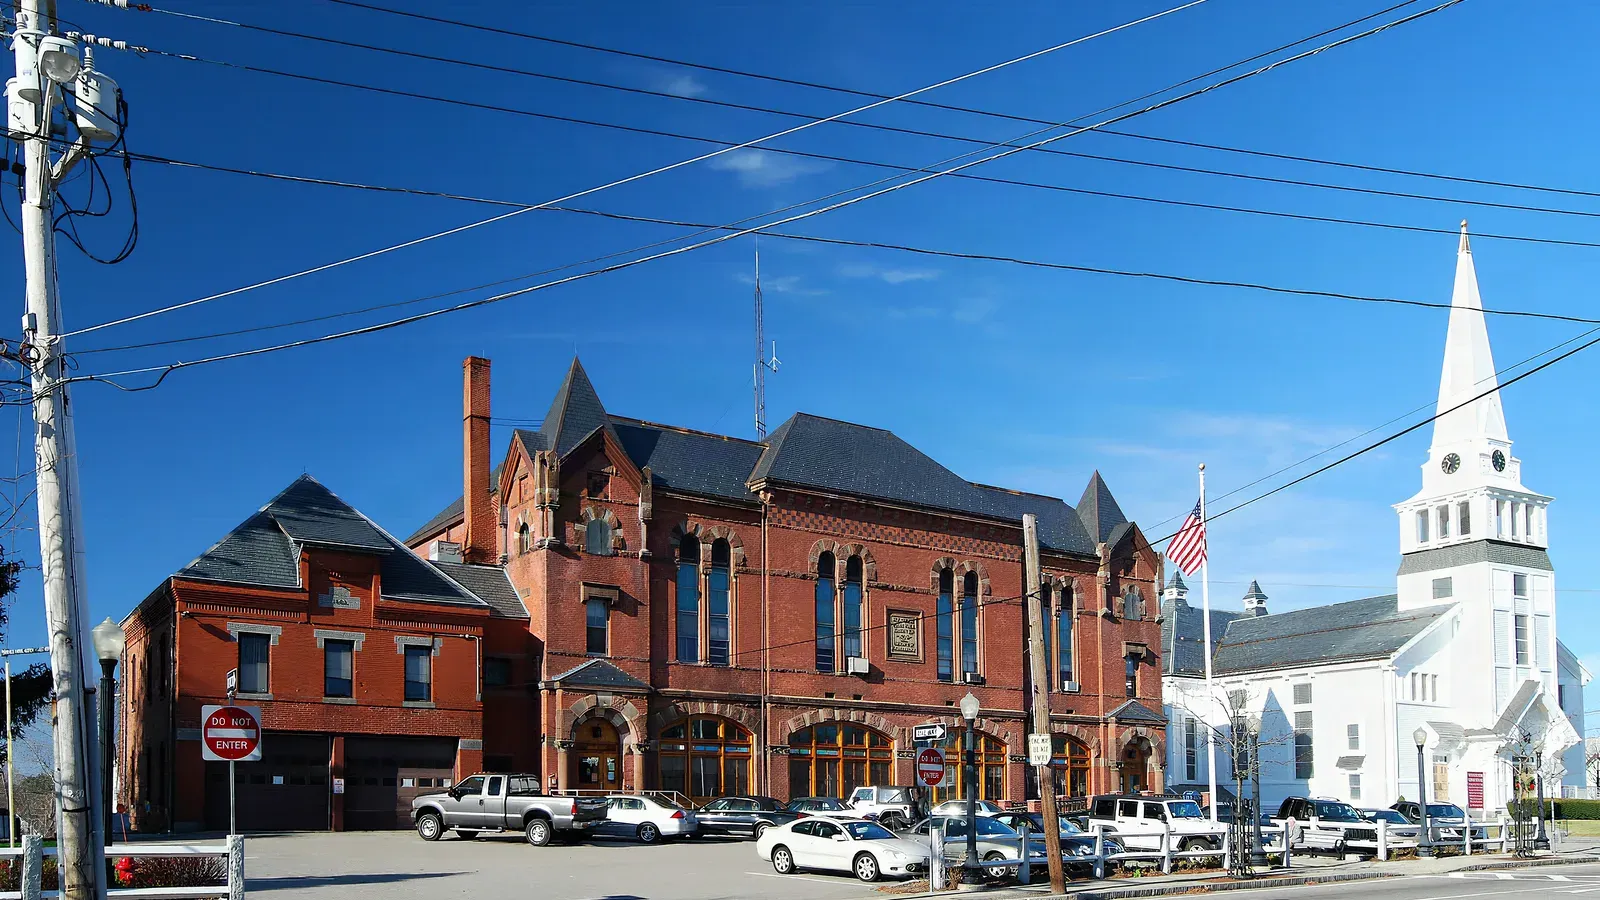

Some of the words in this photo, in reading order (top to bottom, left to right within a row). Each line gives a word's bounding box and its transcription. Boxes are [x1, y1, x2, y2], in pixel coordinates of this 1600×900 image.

[212, 717, 226, 726] DO
[231, 717, 251, 726] NOT
[216, 740, 248, 749] ENTER
[923, 771, 940, 779] ENTER
